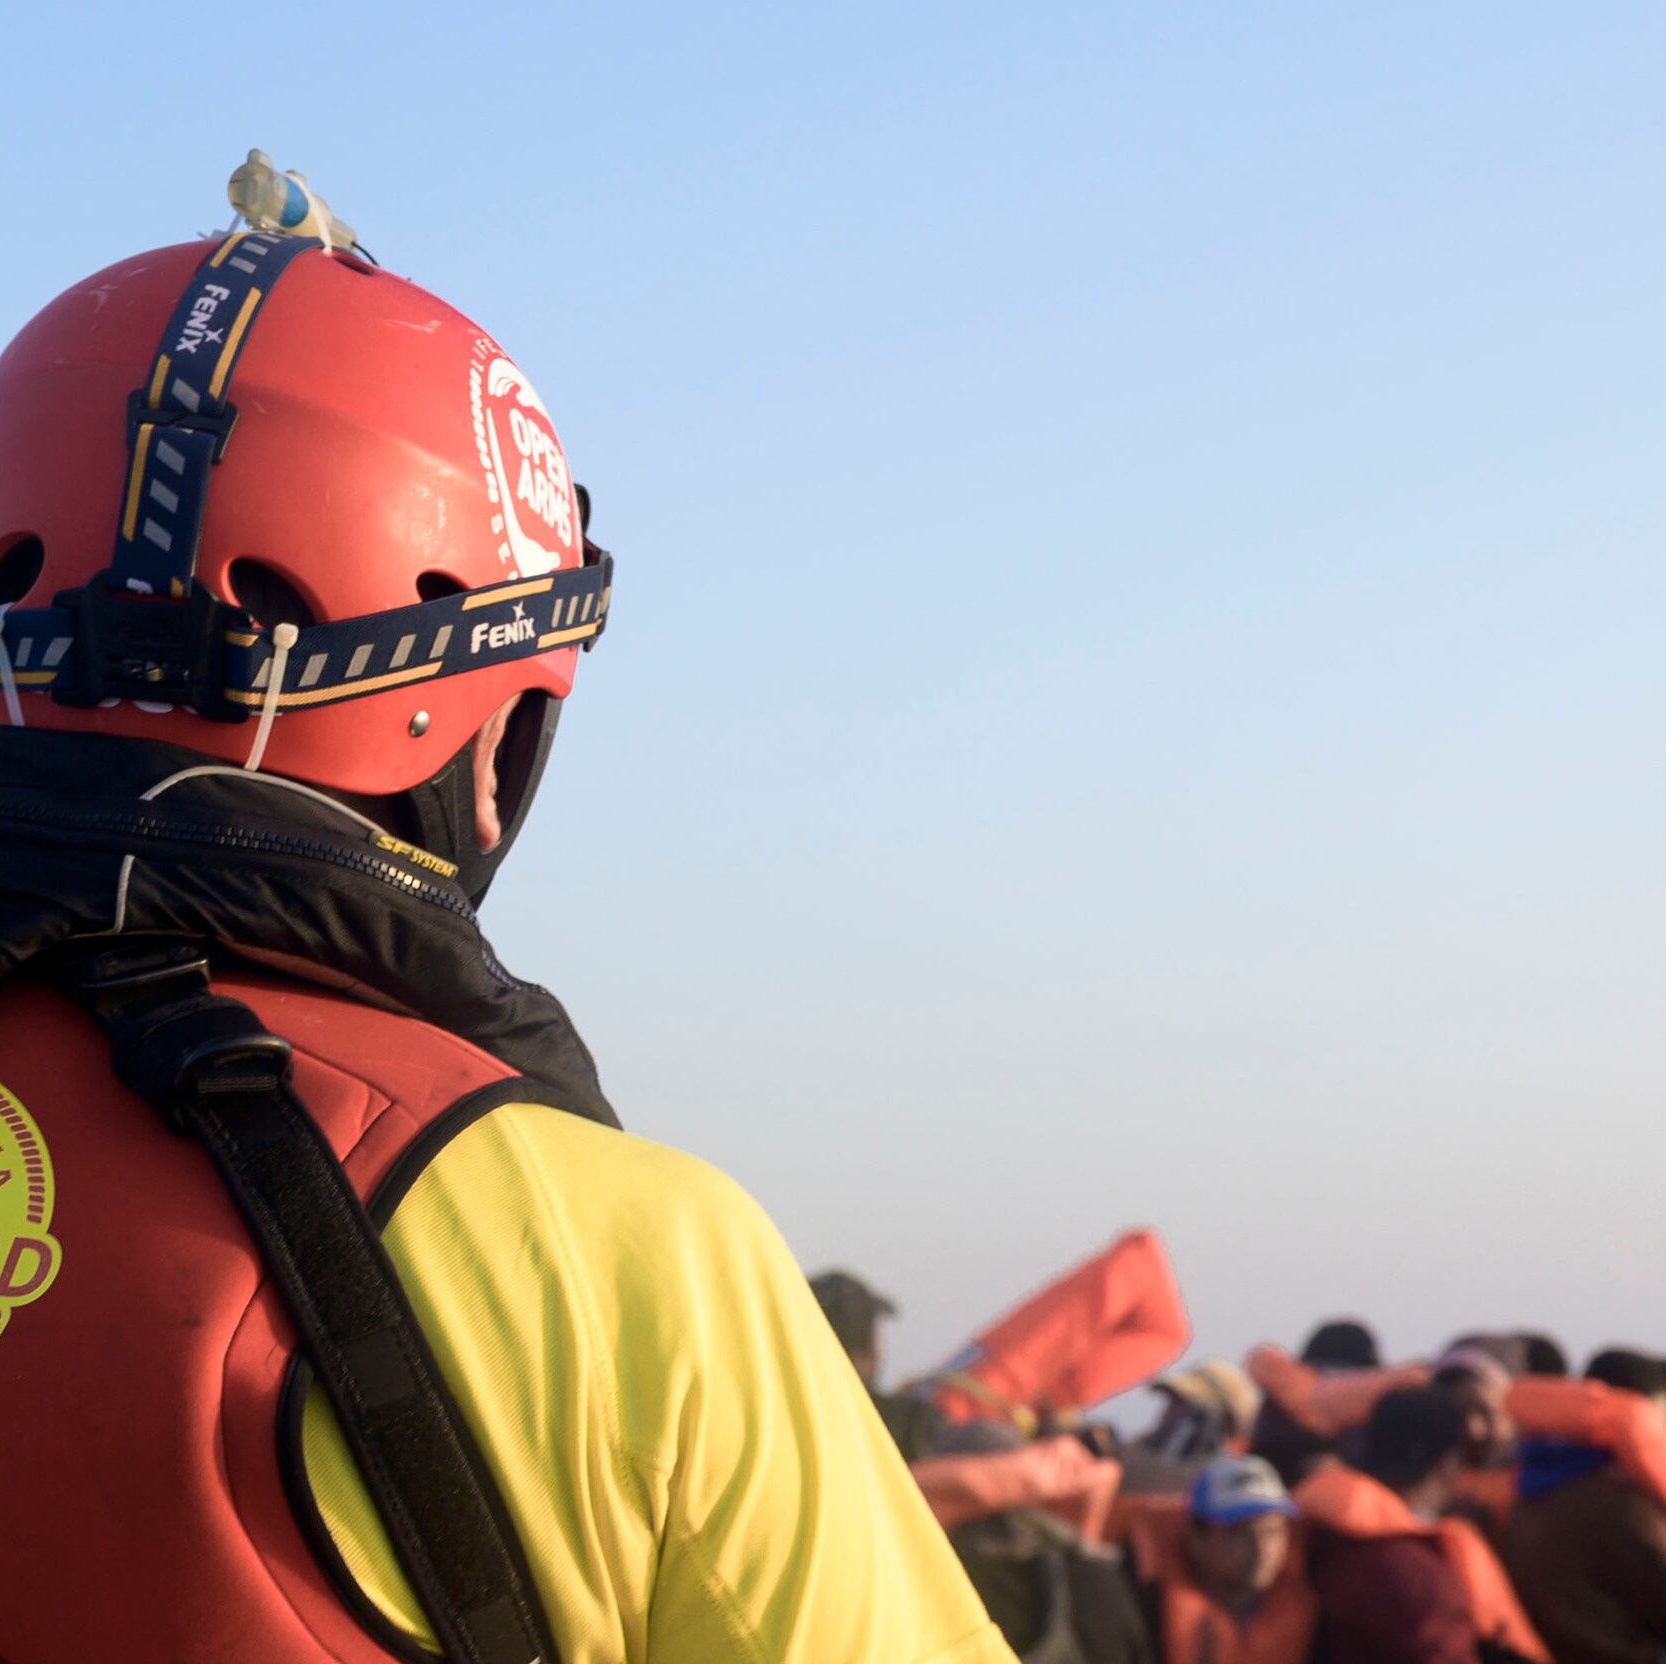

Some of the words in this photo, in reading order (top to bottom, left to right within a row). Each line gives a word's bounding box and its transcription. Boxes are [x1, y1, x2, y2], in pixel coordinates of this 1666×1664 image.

[175, 283, 230, 354] FENIX
[509, 408, 571, 501] OPEN
[517, 458, 572, 547] ARMS
[471, 617, 536, 654] FENIX
[376, 836, 413, 855] SF
[410, 849, 457, 877] SYSTEM
